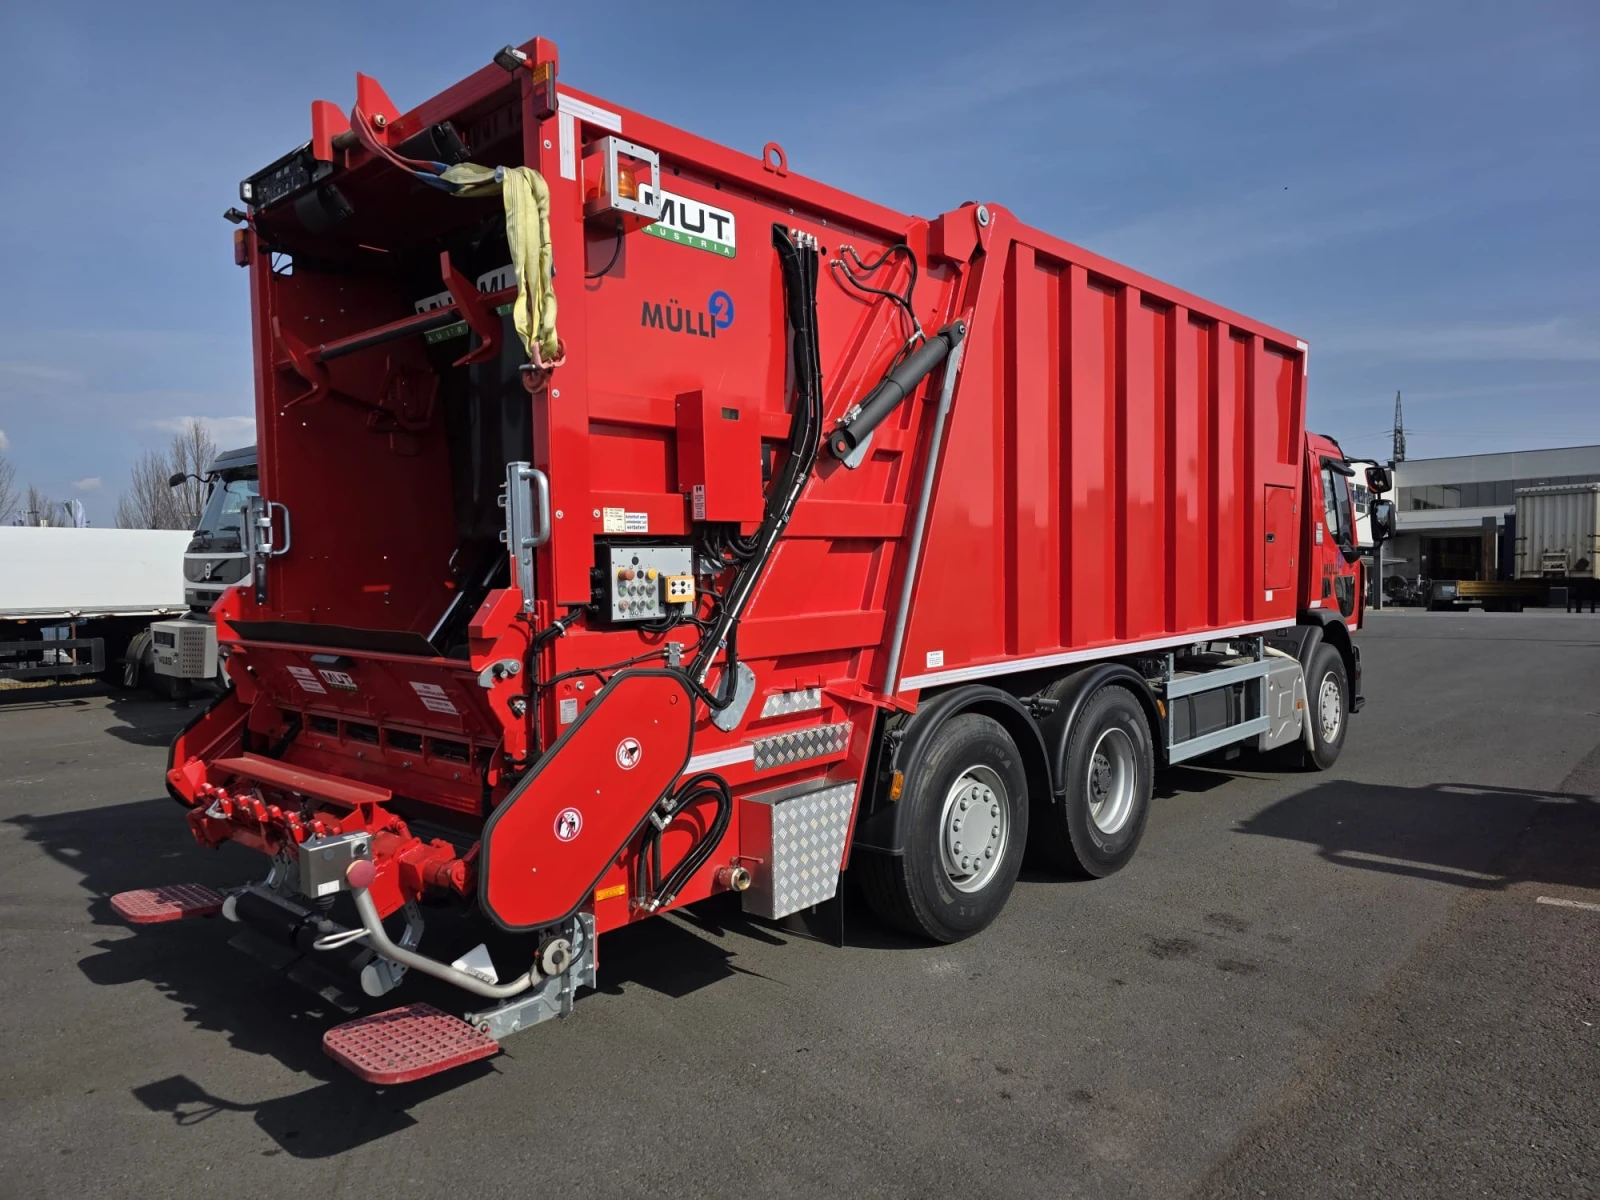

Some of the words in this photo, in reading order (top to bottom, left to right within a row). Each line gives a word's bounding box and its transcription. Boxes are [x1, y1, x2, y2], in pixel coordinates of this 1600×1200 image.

[645, 191, 730, 240] MUT
[646, 225, 730, 255] AUSTRIA
[321, 671, 353, 686] MUT
